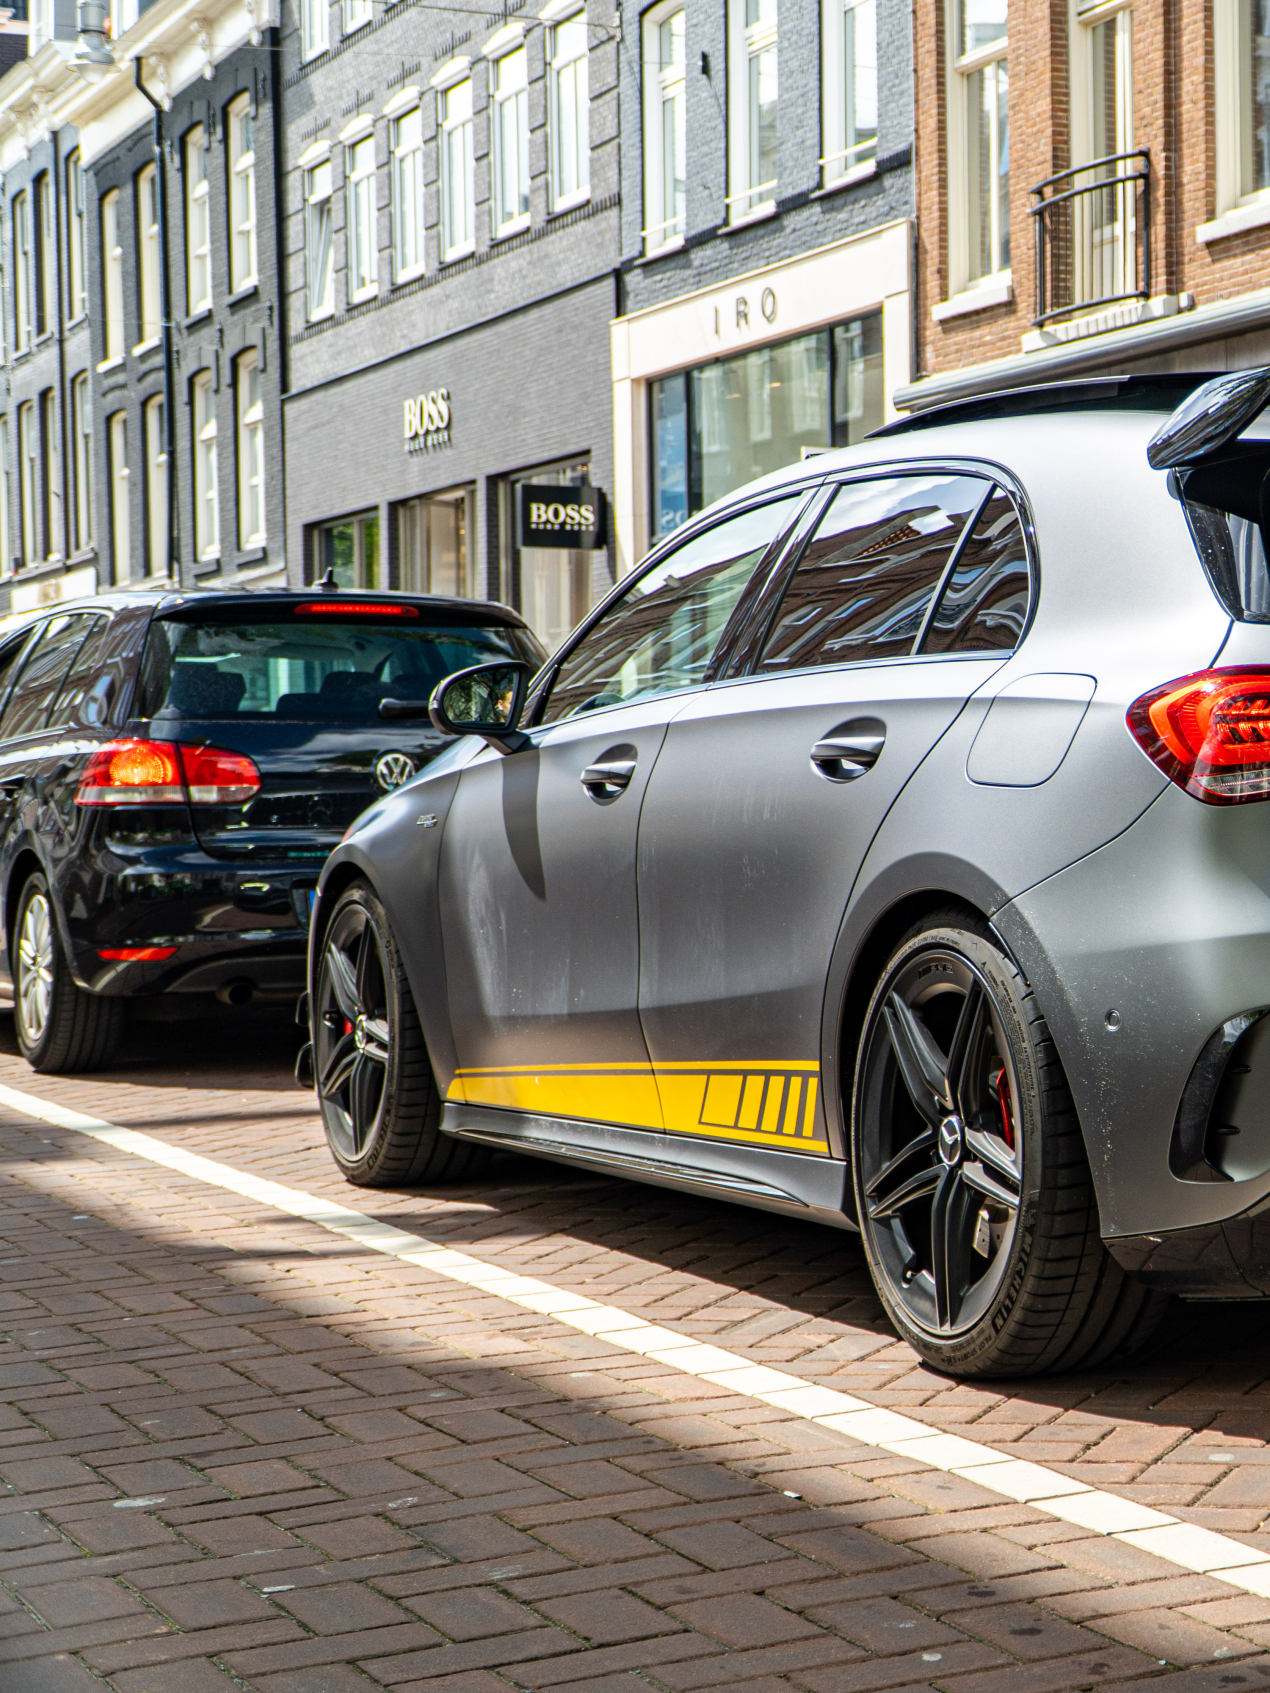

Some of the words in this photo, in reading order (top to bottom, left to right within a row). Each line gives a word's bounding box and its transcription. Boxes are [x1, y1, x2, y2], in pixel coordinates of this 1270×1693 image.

[714, 287, 778, 336] IRO
[403, 387, 450, 438] BOSS
[530, 503, 595, 525] BOSS
[992, 1231, 1033, 1334] MICHELIN
